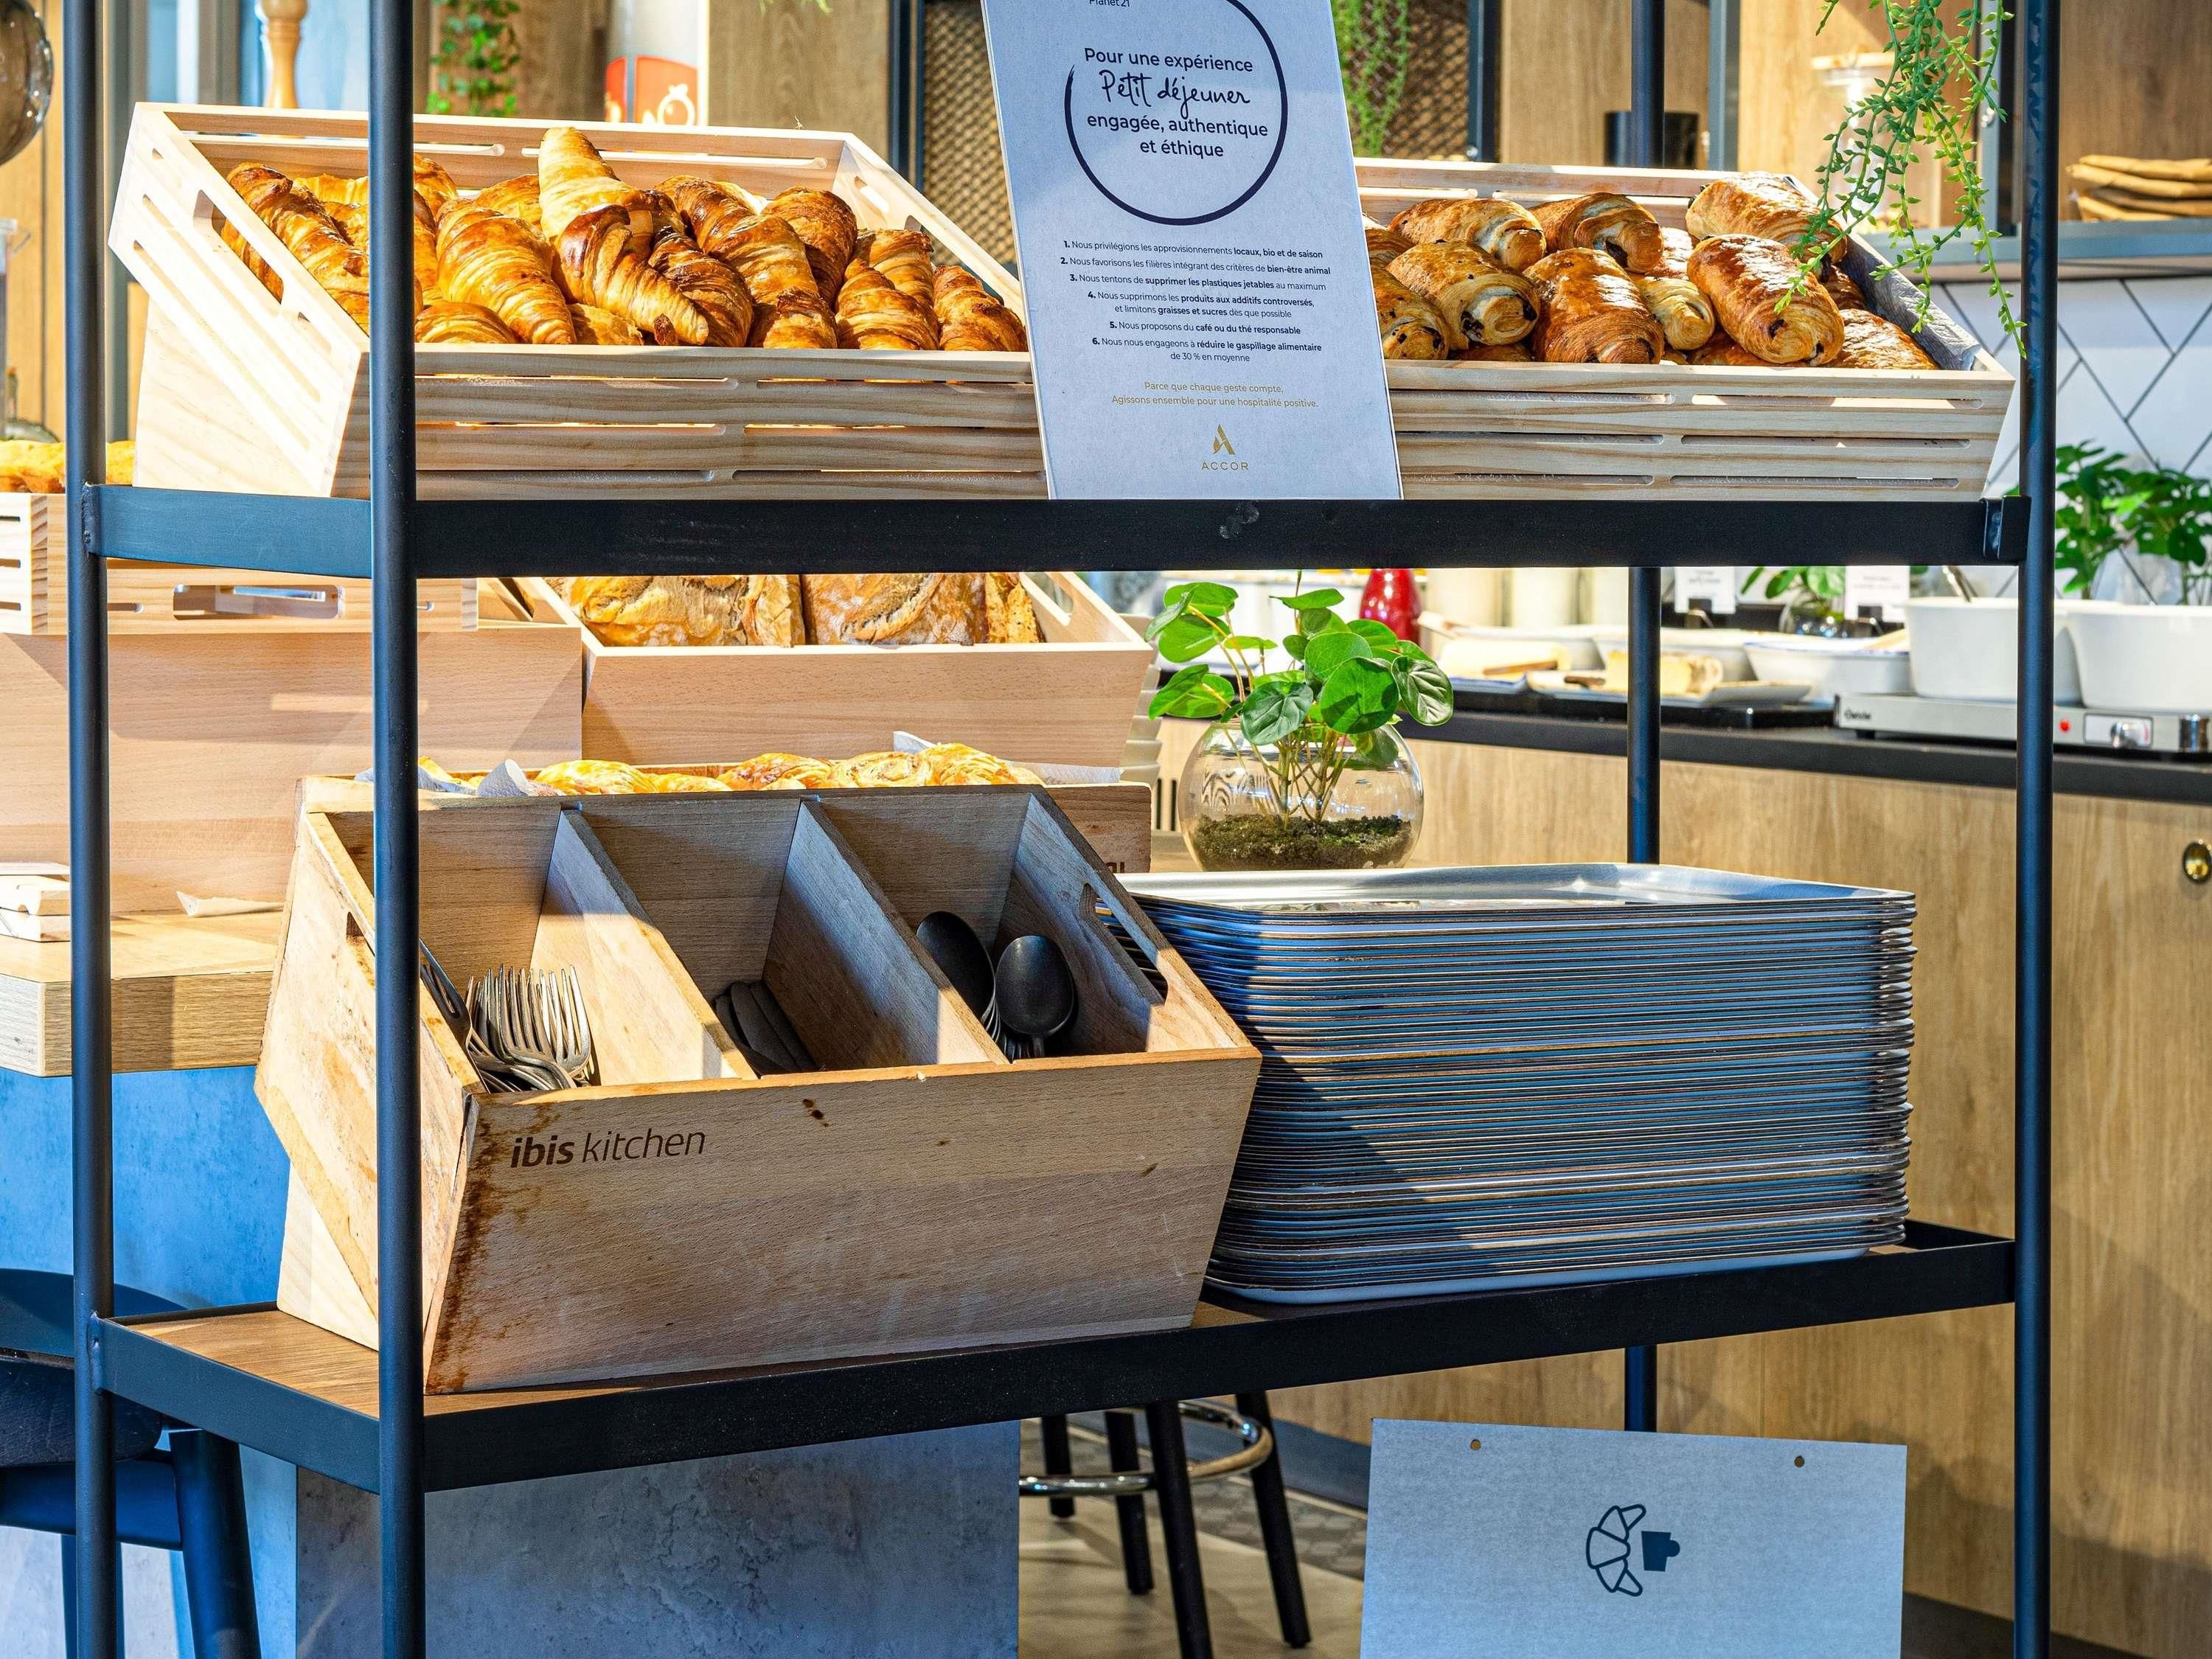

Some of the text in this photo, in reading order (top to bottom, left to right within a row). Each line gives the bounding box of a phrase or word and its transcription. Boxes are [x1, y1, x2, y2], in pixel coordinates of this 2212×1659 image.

[1085, 47, 1253, 73] Pour une expérience
[1099, 70, 1251, 119] Petit déjeuner
[1086, 114, 1268, 139] engagée, authentique
[1139, 138, 1224, 159] et éthique
[1071, 241, 1093, 249] Nous
[1094, 241, 1139, 252] privilégions
[1141, 243, 1152, 251] les
[1153, 244, 1233, 254] approvisionnements
[1234, 247, 1262, 257] locaux,
[1263, 248, 1276, 257] bio
[1287, 249, 1297, 257] de
[1298, 250, 1323, 258] saison
[1069, 257, 1091, 265] Nous
[1092, 258, 1132, 267] favorisons
[1133, 260, 1144, 268] les
[1145, 260, 1172, 268] filières
[1173, 260, 1209, 271] intégrant
[1210, 262, 1225, 271] des
[1225, 263, 1254, 271] critères
[1255, 264, 1265, 272] de
[1267, 265, 1303, 274] bien-être
[1079, 274, 1100, 282] Nous
[1133, 276, 1144, 284] de
[1145, 277, 1187, 286] supprimer
[1188, 277, 1200, 286] les
[1202, 279, 1242, 288] plastiques
[1243, 279, 1275, 289] jetables
[1097, 291, 1119, 299] Nous
[1120, 292, 1167, 302] supprimons
[1180, 294, 1214, 303] produits
[1231, 296, 1262, 305] additifs
[1263, 298, 1315, 307] controversés,
[1124, 305, 1157, 313] limitons
[1158, 306, 1191, 316] graisses
[1228, 308, 1242, 316] dès
[1261, 310, 1292, 319] possible
[1119, 321, 1140, 330] Nous
[1141, 323, 1182, 331] proposons
[1195, 324, 1212, 332] café
[1226, 324, 1237, 333] du
[1253, 326, 1301, 335] responsable
[1102, 338, 1122, 346] Nous
[1145, 340, 1189, 349] engageons
[1197, 340, 1225, 349] réduire
[1227, 341, 1234, 349] le
[1236, 341, 1276, 351] gaspillage
[1278, 342, 1322, 351] alimentaire
[1214, 355, 1251, 363] moyenne
[1144, 382, 1284, 394] Parce que chaque geste compte,
[1112, 395, 1150, 405] Agissons
[1152, 397, 1194, 405] ensemble
[1197, 398, 1217, 406] pour
[1237, 397, 1281, 407] hospitalité
[1284, 400, 1318, 408] positive.
[1201, 462, 1251, 470] ACCOR
[510, 1128, 706, 1168] ibis kitchen
